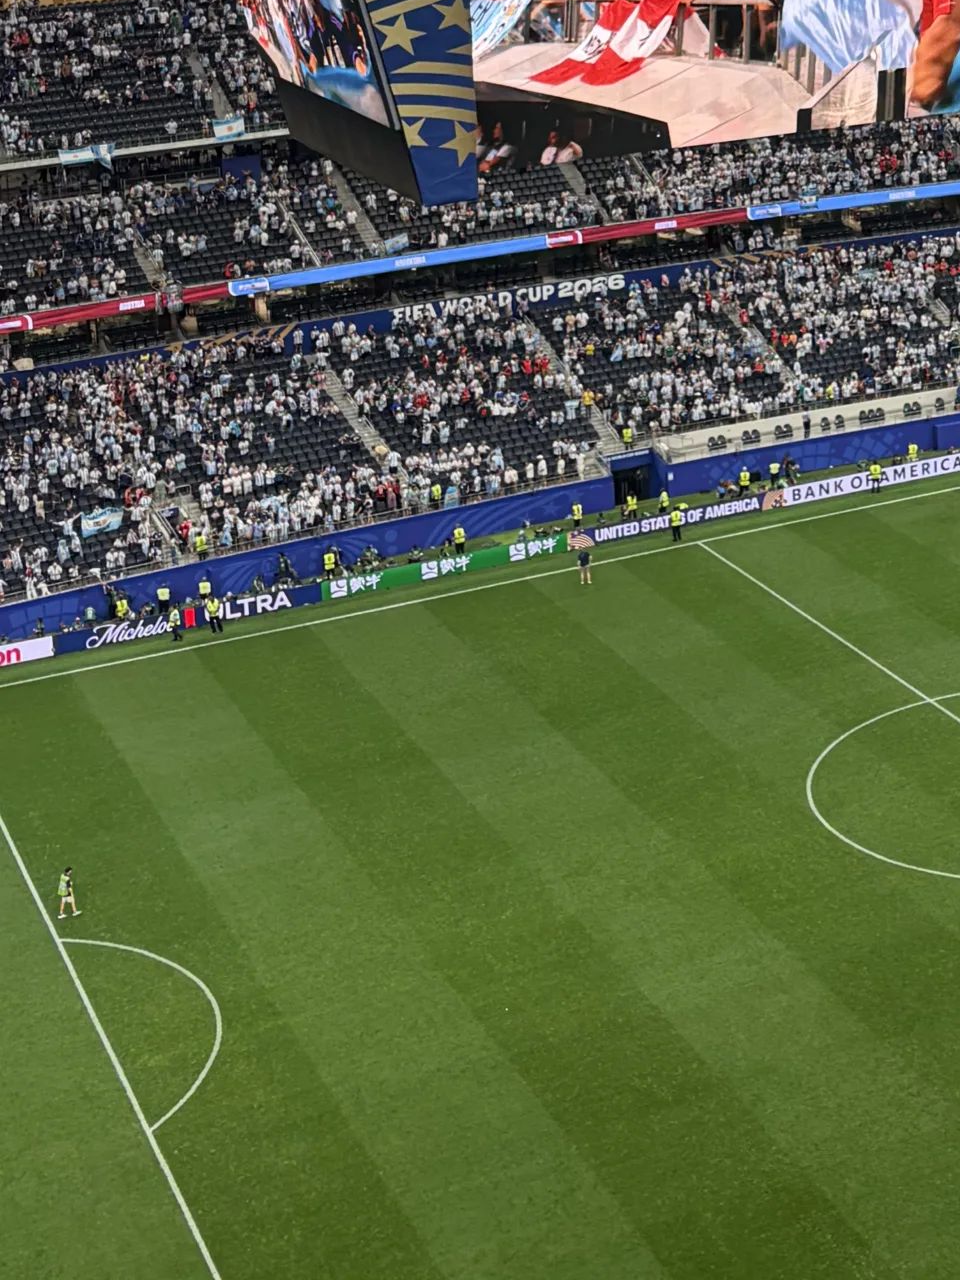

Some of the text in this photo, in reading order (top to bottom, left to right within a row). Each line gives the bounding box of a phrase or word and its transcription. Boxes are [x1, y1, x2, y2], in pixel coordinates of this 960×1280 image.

[391, 304, 436, 322] FIFA
[515, 284, 555, 309] CUP
[557, 273, 626, 300] 2026
[791, 478, 844, 502] BANK
[594, 497, 760, 542] UNITED STATS OF AMERICA
[85, 615, 174, 649] Michelo
